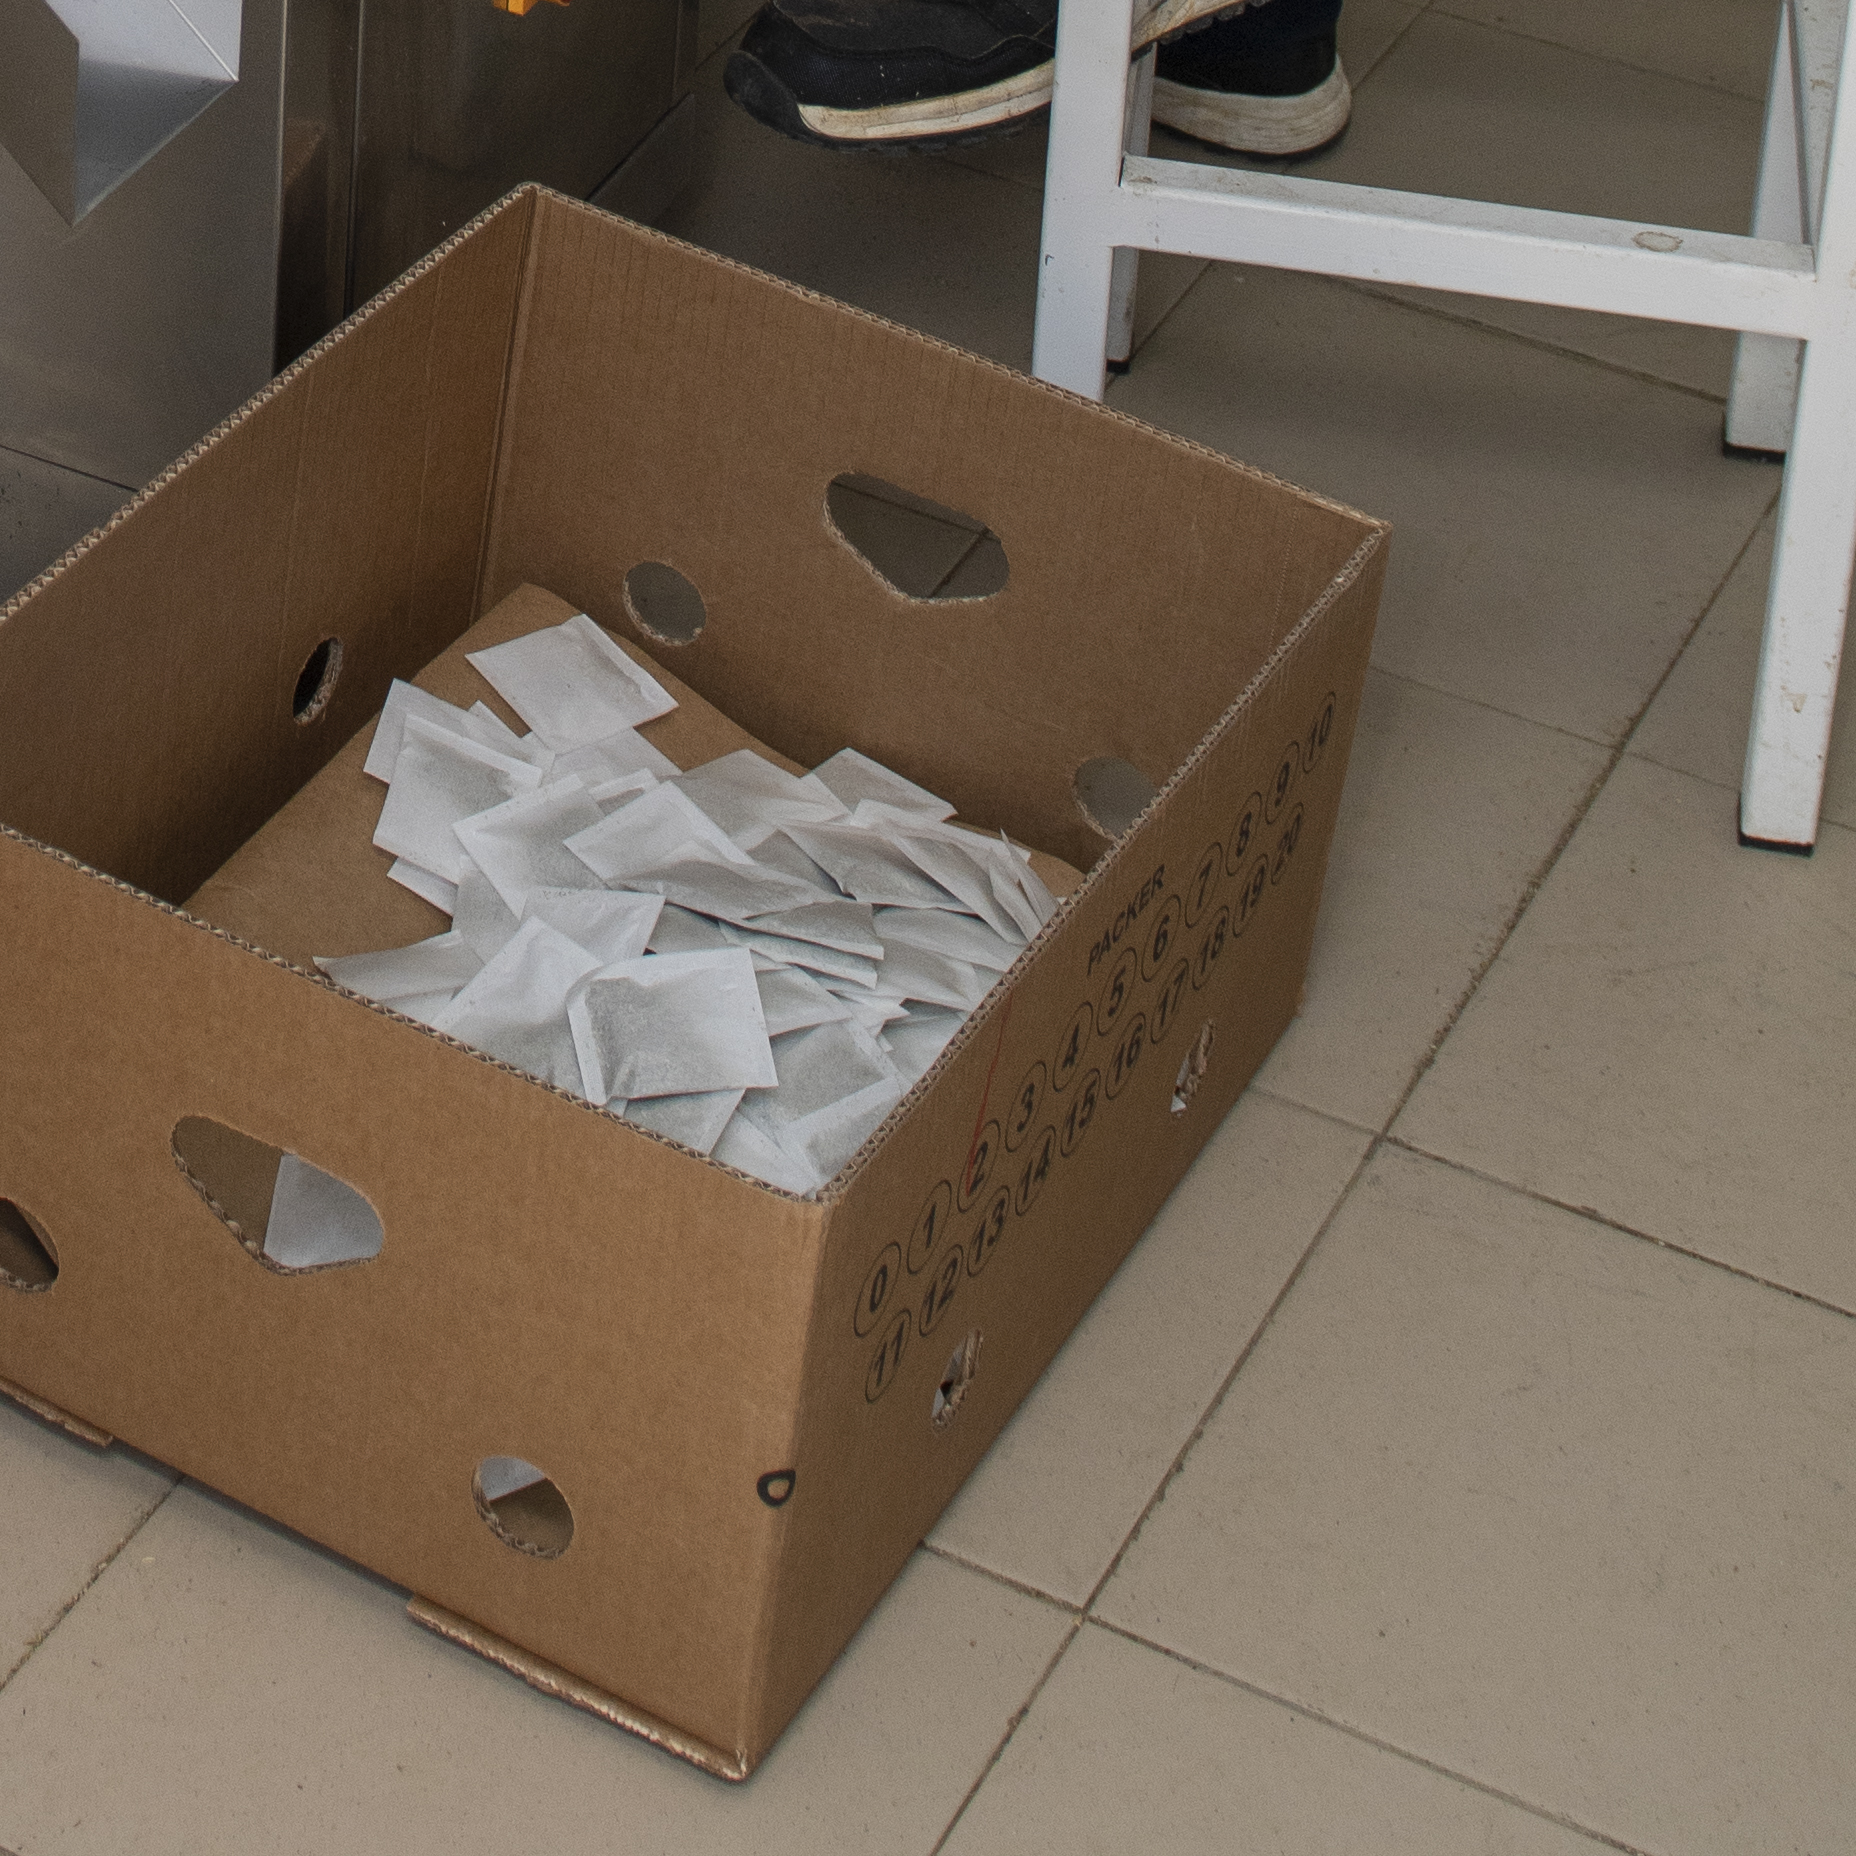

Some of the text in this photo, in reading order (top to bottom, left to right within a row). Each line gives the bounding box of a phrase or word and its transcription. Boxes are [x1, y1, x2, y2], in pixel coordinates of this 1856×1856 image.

[869, 703, 1333, 1314] 0 1 2 3 4 5 6 7 8 9 10
[875, 813, 1301, 1386] 11 12 13 14 15 16 17 18 19 20
[1087, 863, 1165, 977] PACKER
